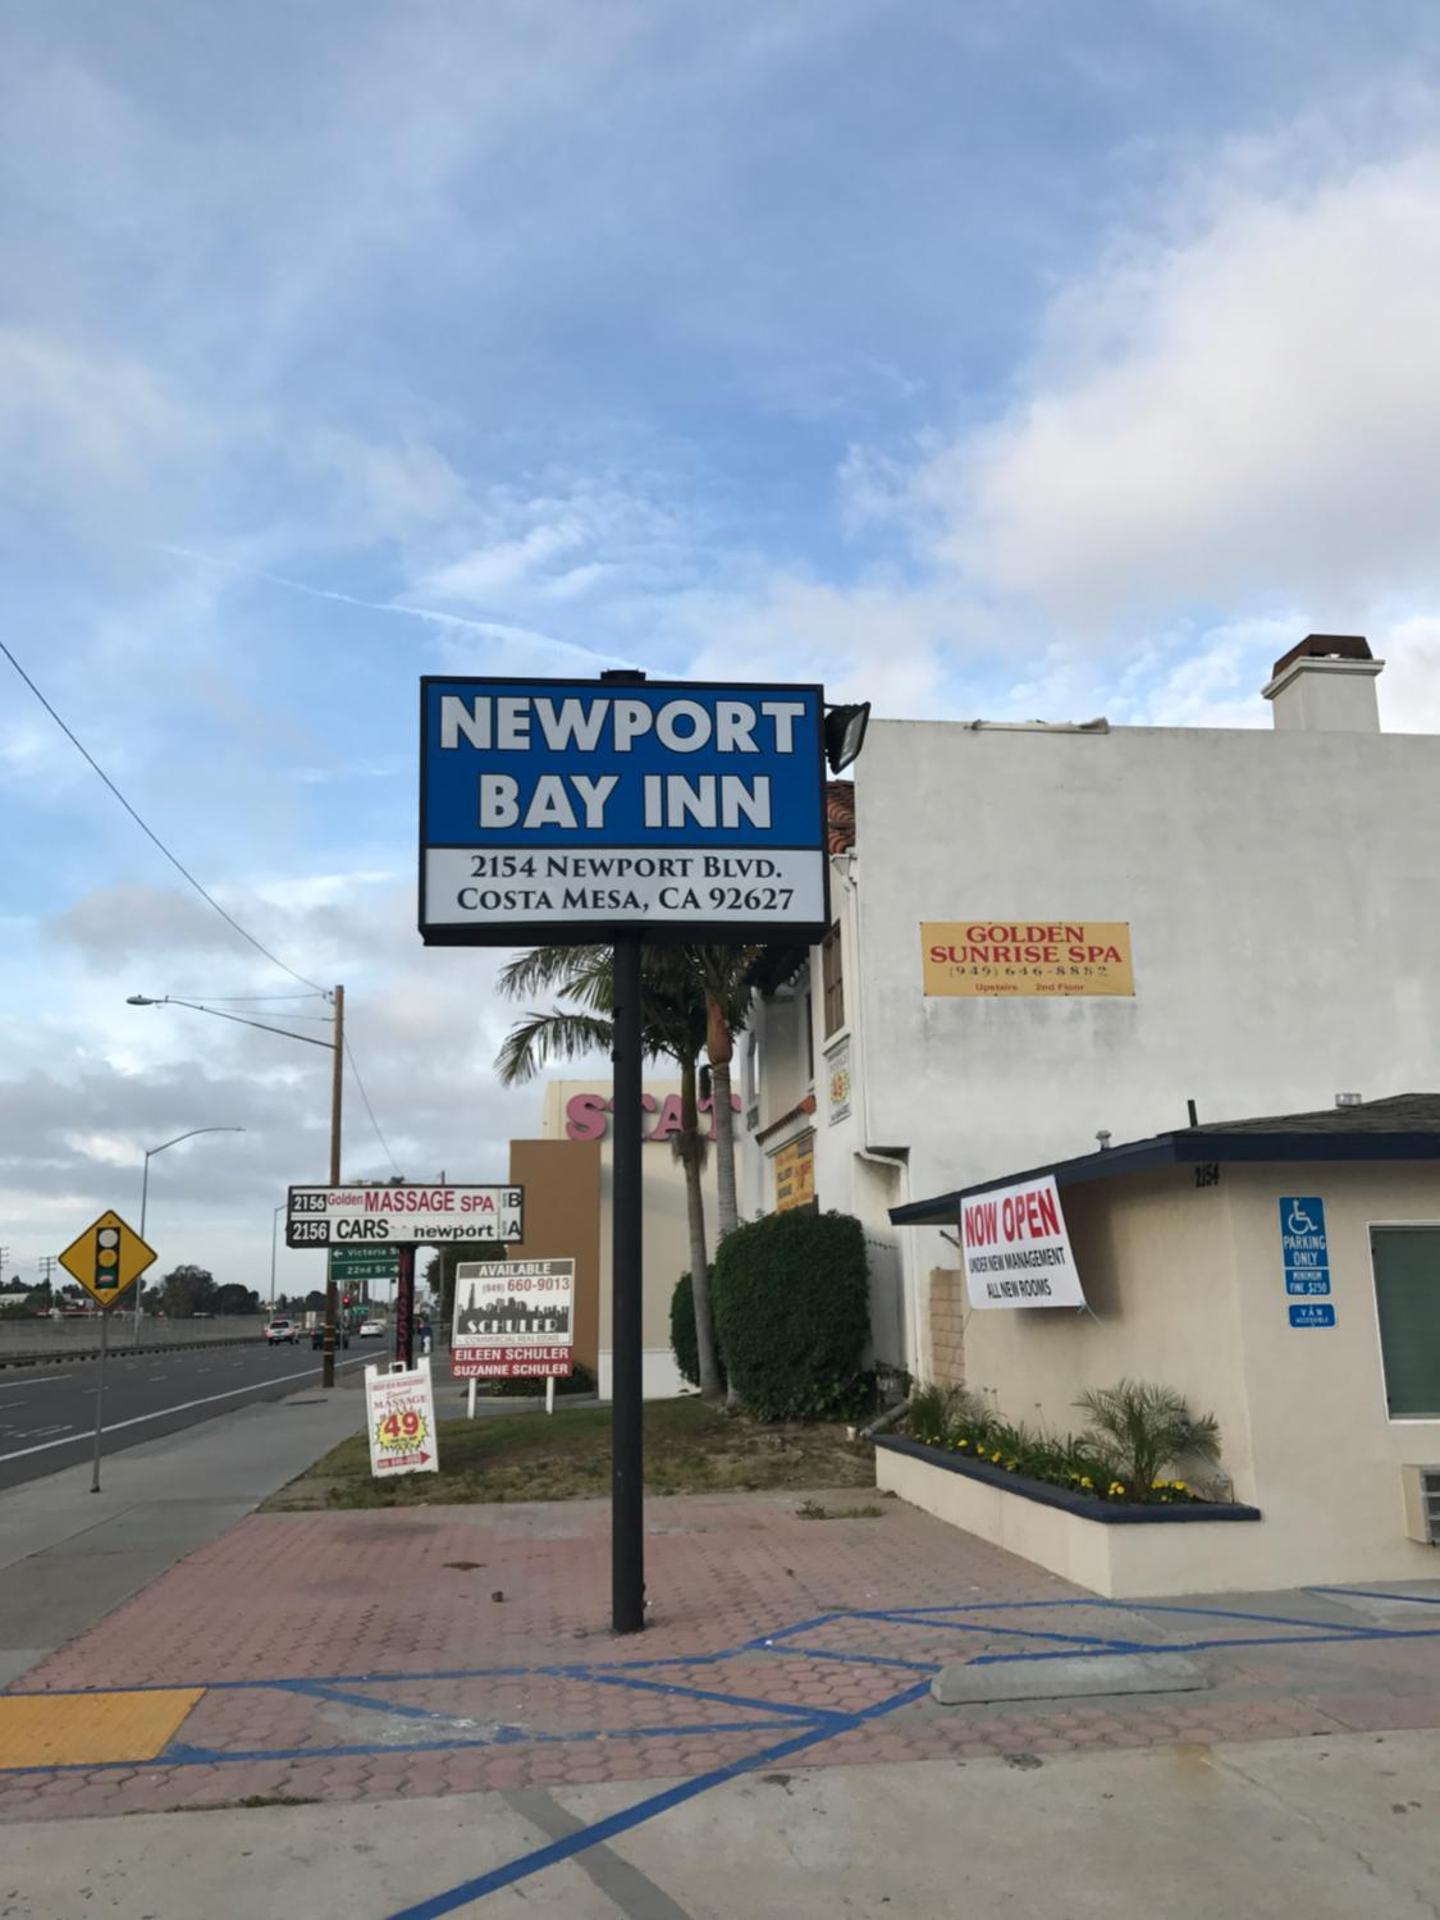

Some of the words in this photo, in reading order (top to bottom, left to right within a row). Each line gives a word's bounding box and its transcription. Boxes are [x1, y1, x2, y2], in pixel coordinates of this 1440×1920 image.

[440, 695, 805, 754] NEWPORT
[480, 774, 619, 829] BAY
[644, 775, 772, 829] INN
[471, 855, 537, 878] 2154
[547, 856, 693, 879] NEWPORT
[704, 857, 782, 880] BLVD.
[457, 887, 552, 910] COSTA
[562, 888, 649, 913] MESA,
[659, 888, 702, 910] CA
[709, 888, 794, 911] 92627
[966, 926, 1085, 943] GOLDEN
[930, 946, 1060, 964] SUNRISE
[1068, 946, 1123, 963] SPA
[975, 983, 1018, 993] Upstairs
[1035, 983, 1056, 992] 2nd
[1057, 983, 1085, 992] Floor
[1194, 1163, 1219, 1187] 2154
[294, 1195, 326, 1211] 2156
[327, 1193, 364, 1206] Golden
[365, 1190, 455, 1212] MASSAGE
[460, 1195, 494, 1212] SPA
[508, 1192, 521, 1208] B
[965, 1201, 998, 1248] NOW
[1002, 1188, 1061, 1243] OPEN
[293, 1222, 328, 1240] 2156
[336, 1218, 390, 1239] CARS
[414, 1225, 494, 1240] newport
[508, 1220, 521, 1236] A
[1283, 1235, 1326, 1250] PARKING
[347, 1247, 387, 1257] Victoria
[1292, 1251, 1319, 1266] ONLY
[969, 1255, 989, 1274] UNDER
[988, 1254, 1005, 1273] NEW
[1005, 1247, 1066, 1273] MANAGEMENT
[347, 1265, 371, 1275] 22nd
[375, 1266, 387, 1274] St
[479, 1263, 552, 1277] AVAILABLE
[507, 1277, 570, 1292] 660-9013
[987, 1281, 1001, 1299] ALL
[1001, 1280, 1020, 1298] NEW
[1019, 1278, 1052, 1297] ROOMS
[1300, 1308, 1323, 1317] VAN
[467, 1318, 558, 1334] SCHULER
[455, 1349, 501, 1361] EILEEN
[505, 1347, 569, 1360] SCHULER
[453, 1364, 509, 1376] SUZANNE
[512, 1363, 568, 1375] SCHULER
[384, 1411, 420, 1437] 49
